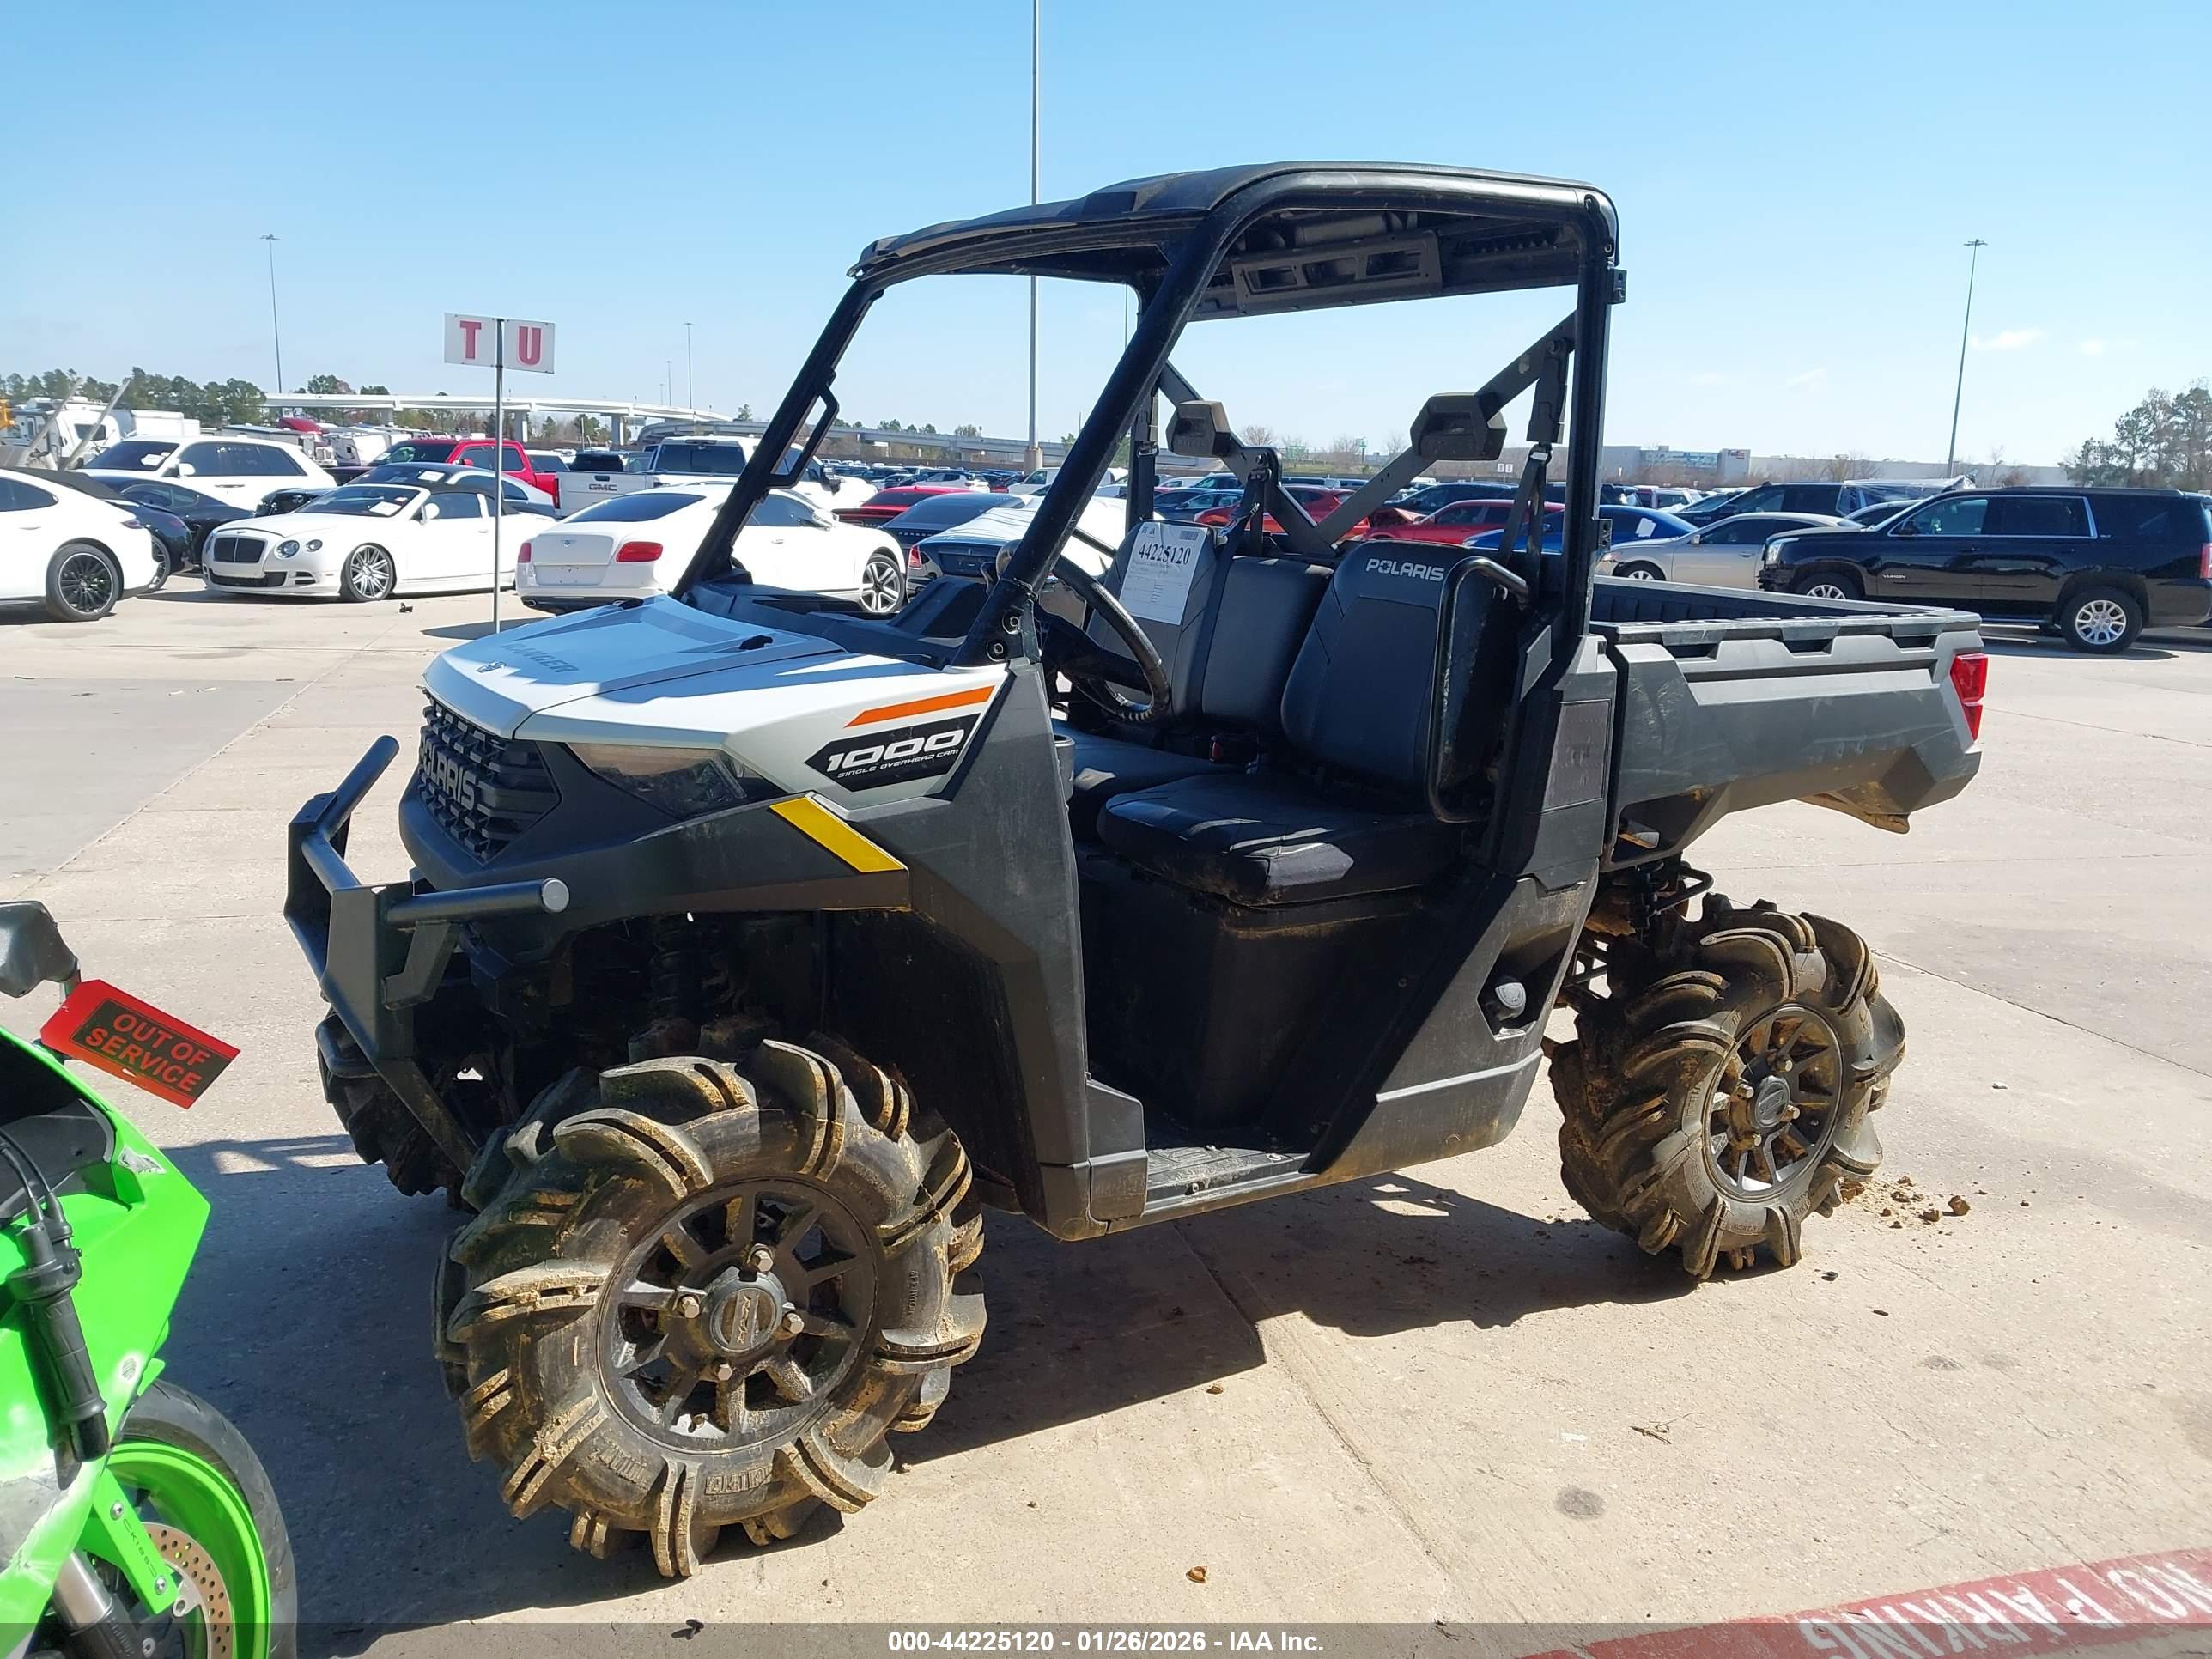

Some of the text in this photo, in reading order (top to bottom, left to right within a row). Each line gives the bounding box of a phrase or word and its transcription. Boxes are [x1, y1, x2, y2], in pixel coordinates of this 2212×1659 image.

[459, 320, 482, 360] T
[518, 325, 542, 366] U
[588, 483, 618, 492] GMC
[1138, 542, 1192, 565] 44225120
[1365, 558, 1445, 582] POLARIS
[501, 643, 580, 673] RANGER
[826, 729, 965, 772] 1000
[837, 749, 959, 779] SINGLE OVERHEAD CAM
[85, 1027, 203, 1092] SERVICE
[112, 1013, 211, 1066] OUT OF
[1797, 1577, 2124, 1659] PARKING
